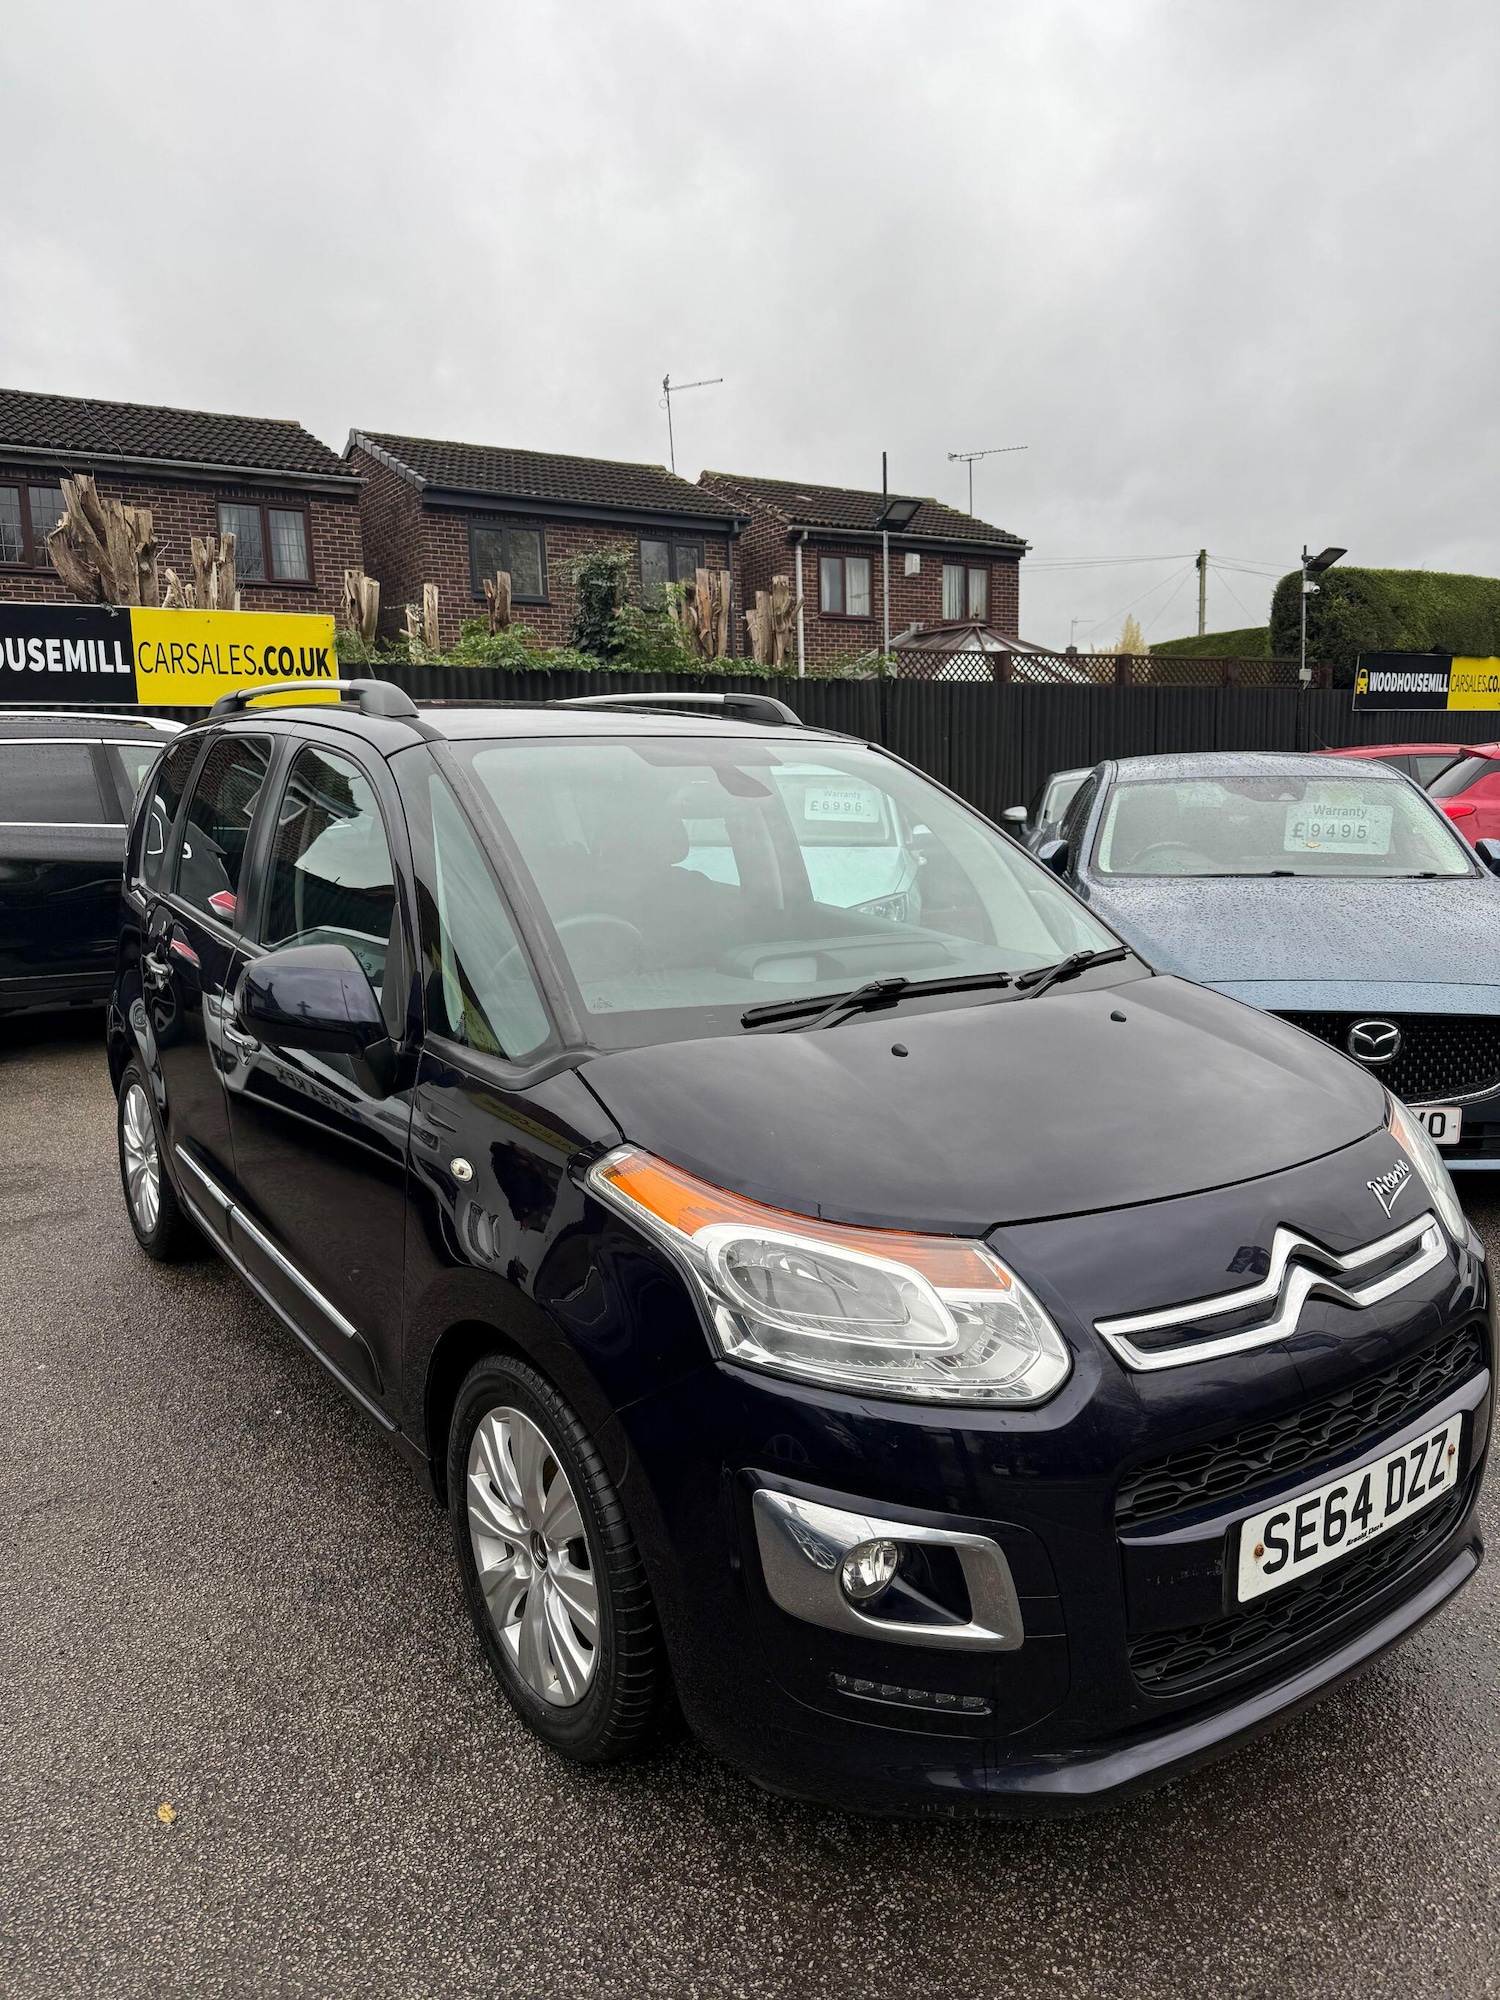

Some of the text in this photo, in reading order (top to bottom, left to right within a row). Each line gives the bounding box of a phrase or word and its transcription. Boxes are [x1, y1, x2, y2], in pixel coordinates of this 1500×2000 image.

[0, 637, 332, 677] USEMILL CARSALES.CO.UK
[1369, 672, 1448, 692] WOODHOUSEMILL
[823, 789, 862, 799] Warranty
[1313, 804, 1368, 819] Warranty
[1292, 821, 1367, 839] £9495
[1262, 1428, 1449, 1575] SE64 DZZ
